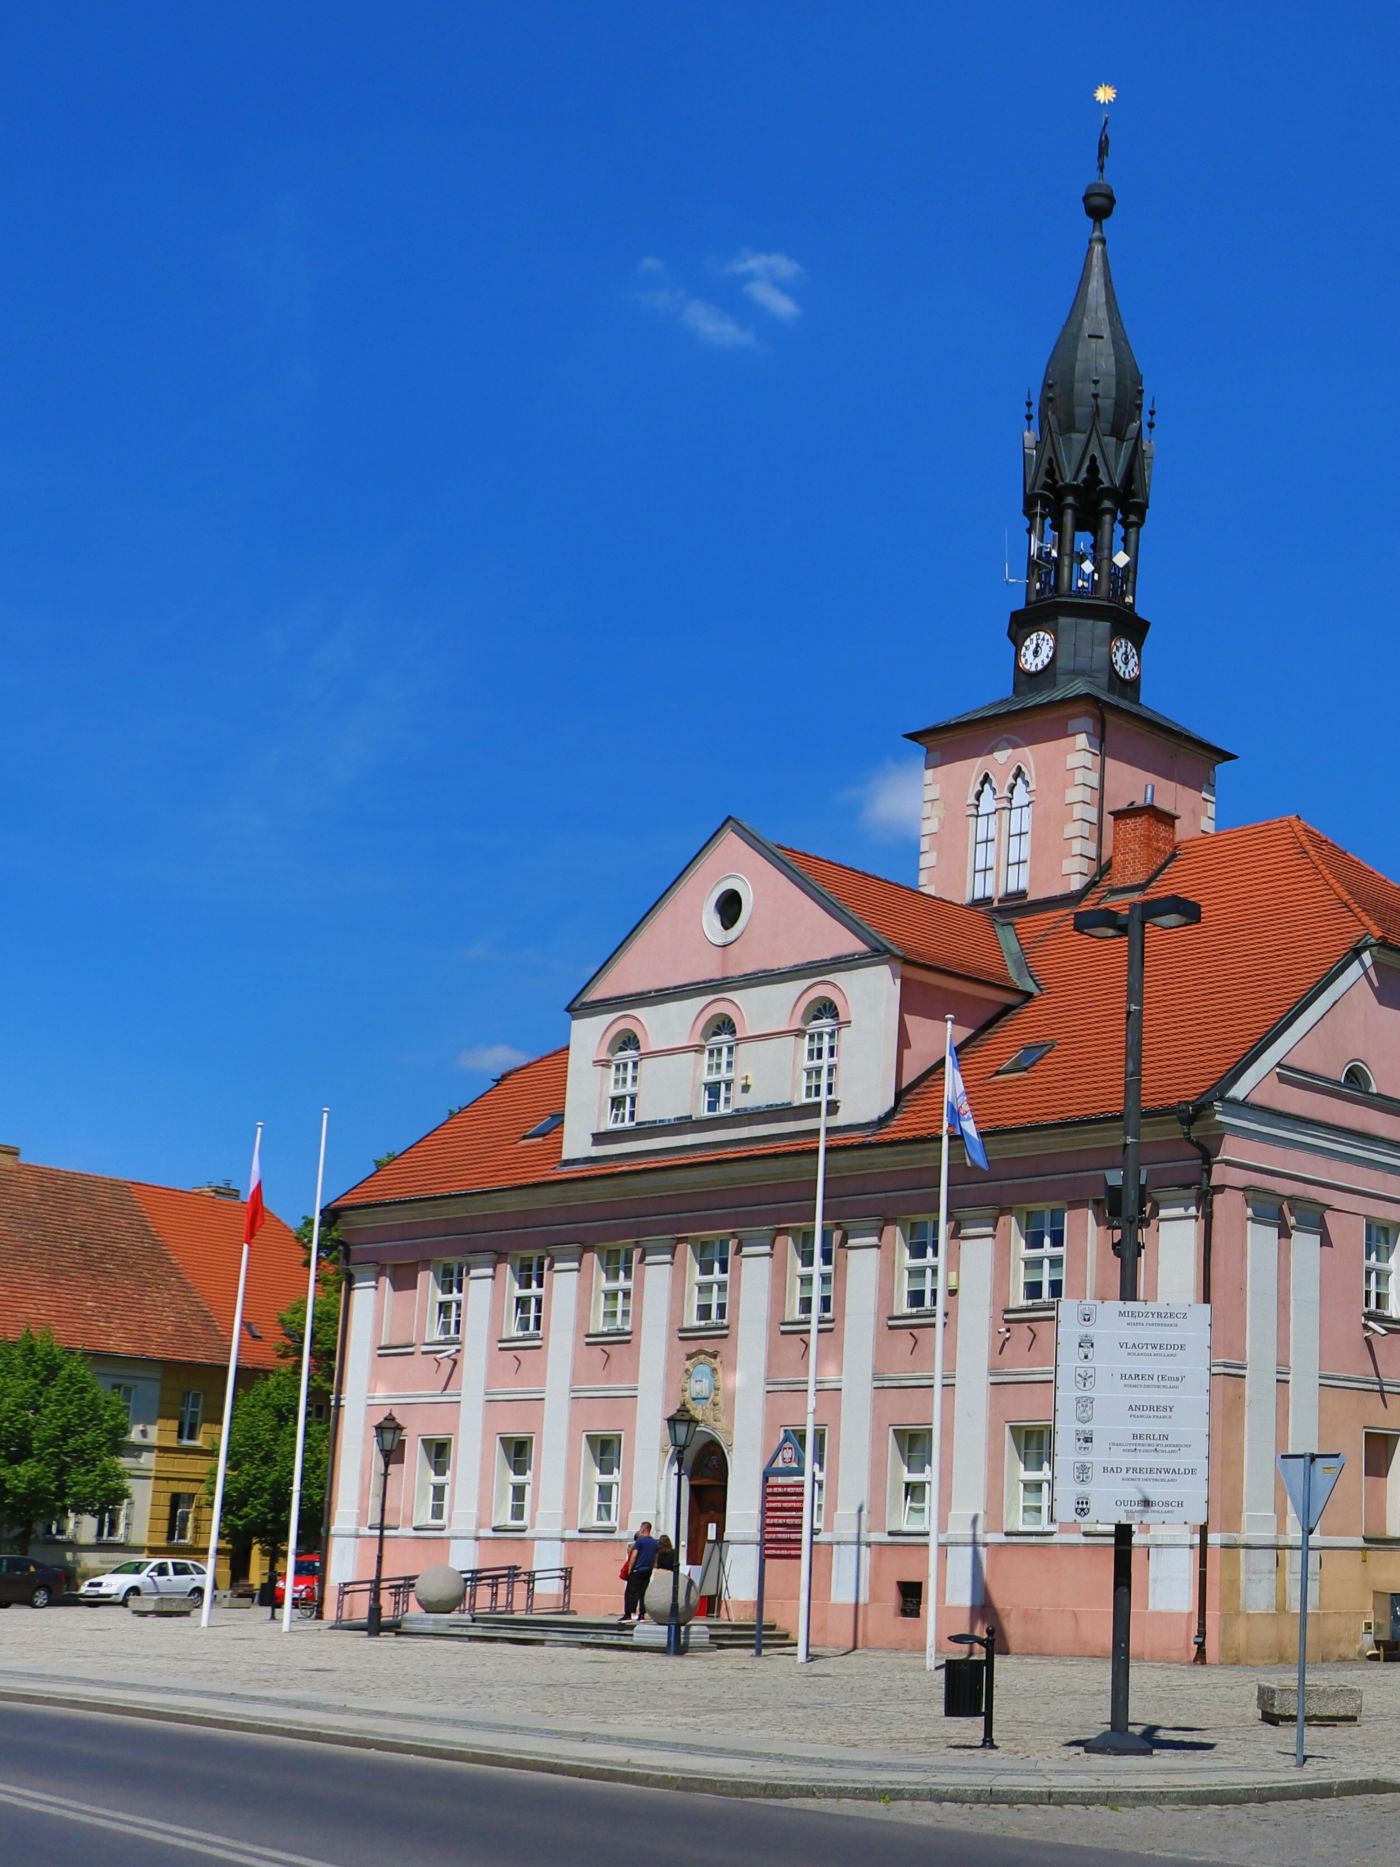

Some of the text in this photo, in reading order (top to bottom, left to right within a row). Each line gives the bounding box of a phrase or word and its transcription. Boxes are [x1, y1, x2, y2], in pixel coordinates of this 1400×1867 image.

[1117, 1310, 1188, 1320] MIĘDZYRZECZ
[1118, 1342, 1187, 1351] VLAGTWEDDE
[1120, 1373, 1155, 1381] HAREN
[1128, 1404, 1175, 1413] ANDRESY
[1132, 1433, 1169, 1441] BERLIN
[1102, 1466, 1198, 1476] BAD FREIENWALDE
